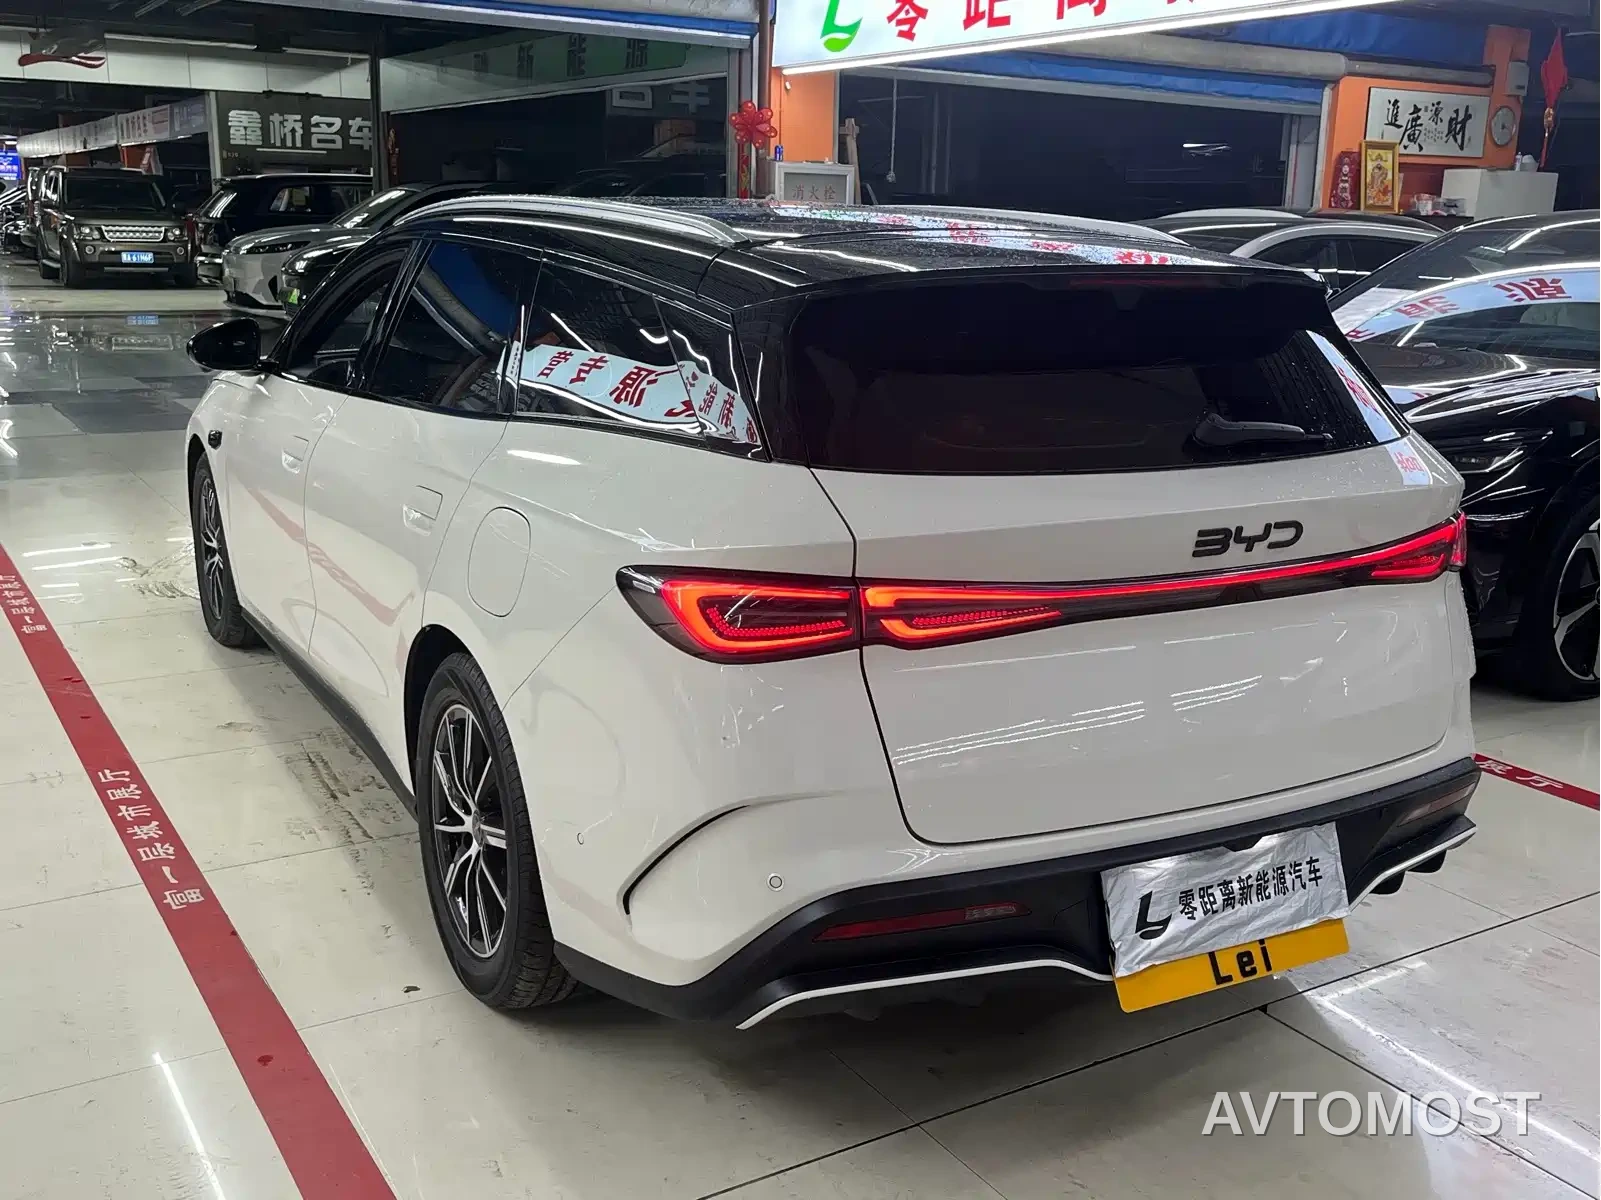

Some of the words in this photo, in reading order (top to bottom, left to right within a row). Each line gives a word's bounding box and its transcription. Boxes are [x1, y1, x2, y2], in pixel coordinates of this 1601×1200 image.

[228, 109, 372, 151] 鑫桥名车
[1192, 520, 1304, 558] BYD
[98, 768, 205, 911] 富一层城市展厅
[1178, 856, 1323, 921] 零距离新能源汽车
[1208, 938, 1273, 986] Lei
